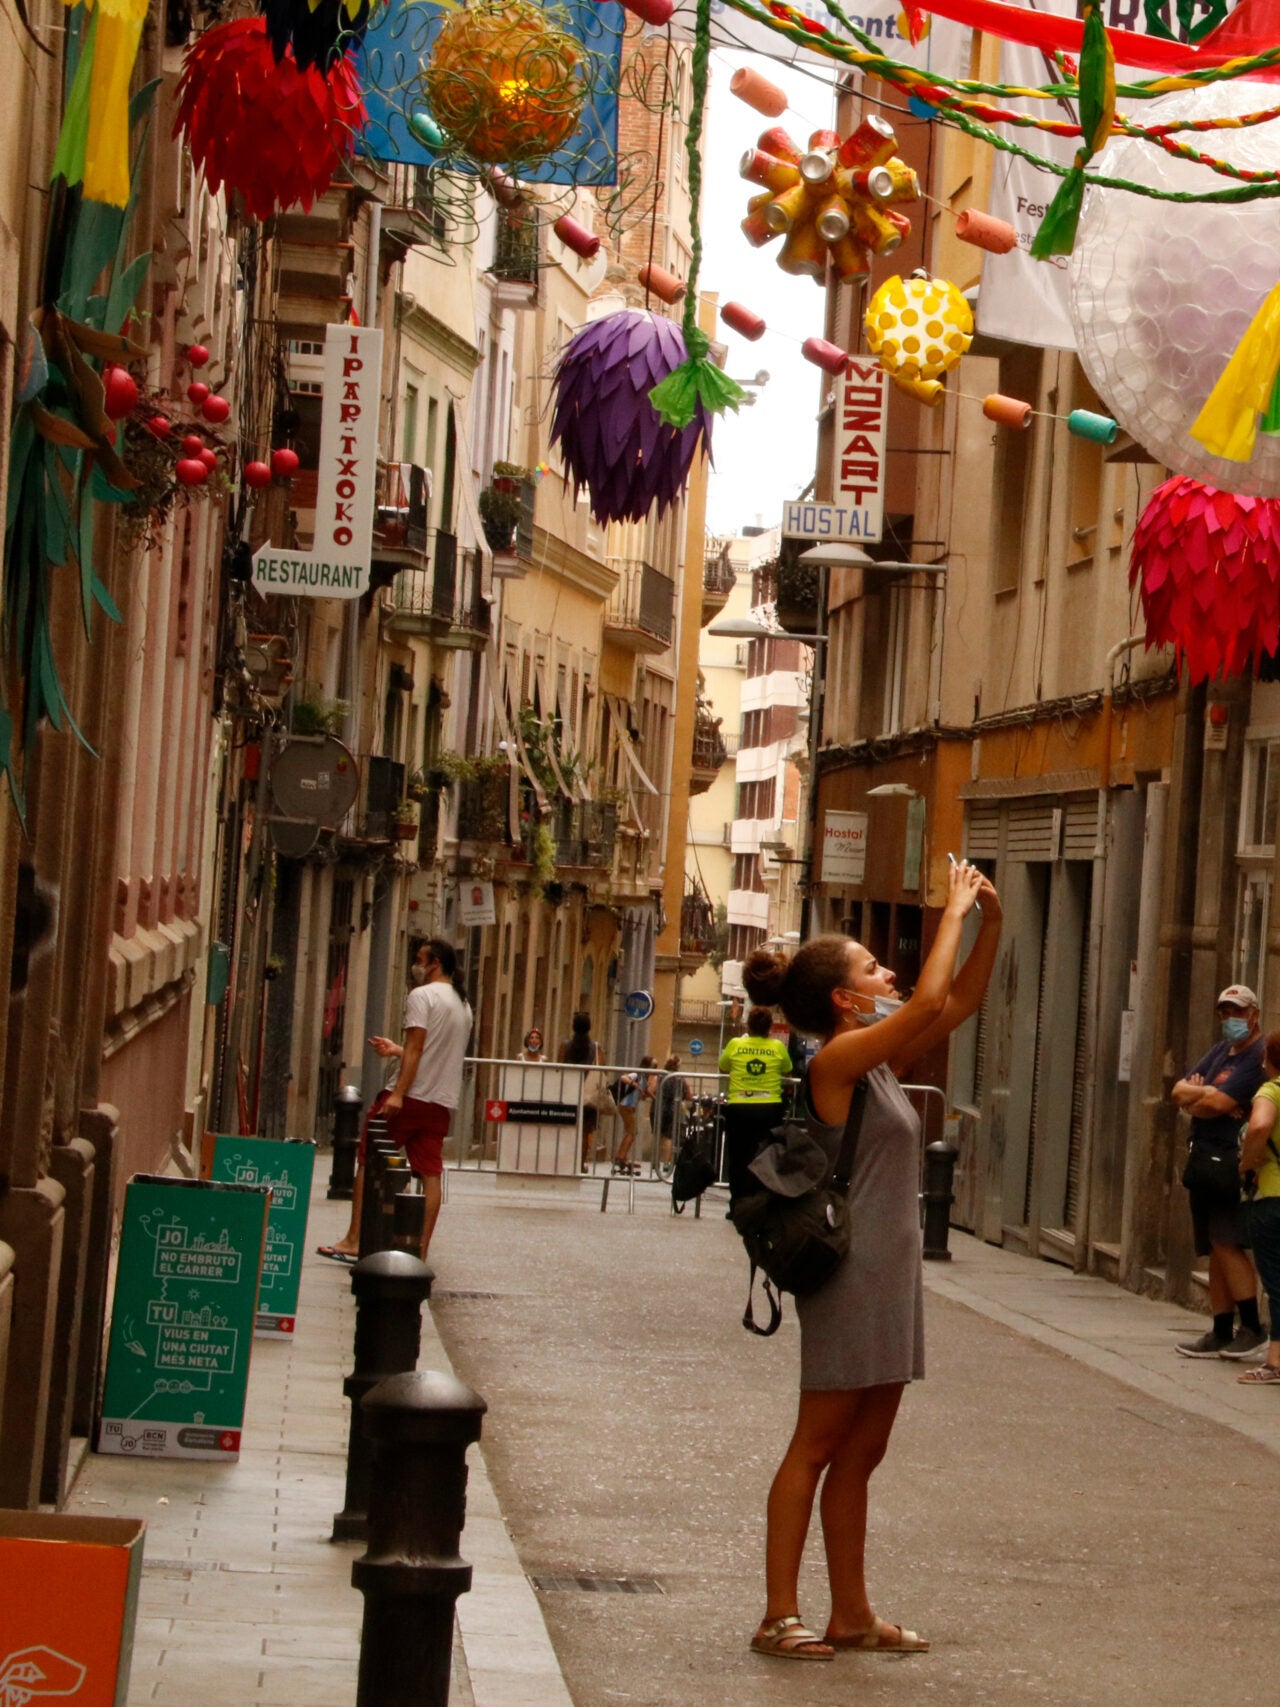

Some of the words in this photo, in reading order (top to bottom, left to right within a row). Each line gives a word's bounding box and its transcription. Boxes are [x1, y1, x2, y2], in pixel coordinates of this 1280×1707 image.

[333, 335, 363, 546] IPAR-TXOKO
[841, 360, 883, 506] MOZART
[788, 506, 876, 537] HOSTAL
[256, 558, 363, 589] RESTAURANT
[825, 827, 863, 840] Hostal
[239, 1170, 254, 1182] JO
[160, 1231, 182, 1245] JO
[160, 1251, 177, 1262] NO
[179, 1253, 235, 1267] EMBRUTO
[159, 1263, 174, 1274] EL
[176, 1265, 223, 1277] CARRER
[152, 1306, 175, 1321] TU
[164, 1328, 190, 1340] VIUS
[193, 1330, 209, 1341] EN
[162, 1341, 187, 1353] UNA
[189, 1343, 230, 1356] CIUTAT
[160, 1353, 185, 1366] MÉS
[188, 1356, 218, 1368] NETA
